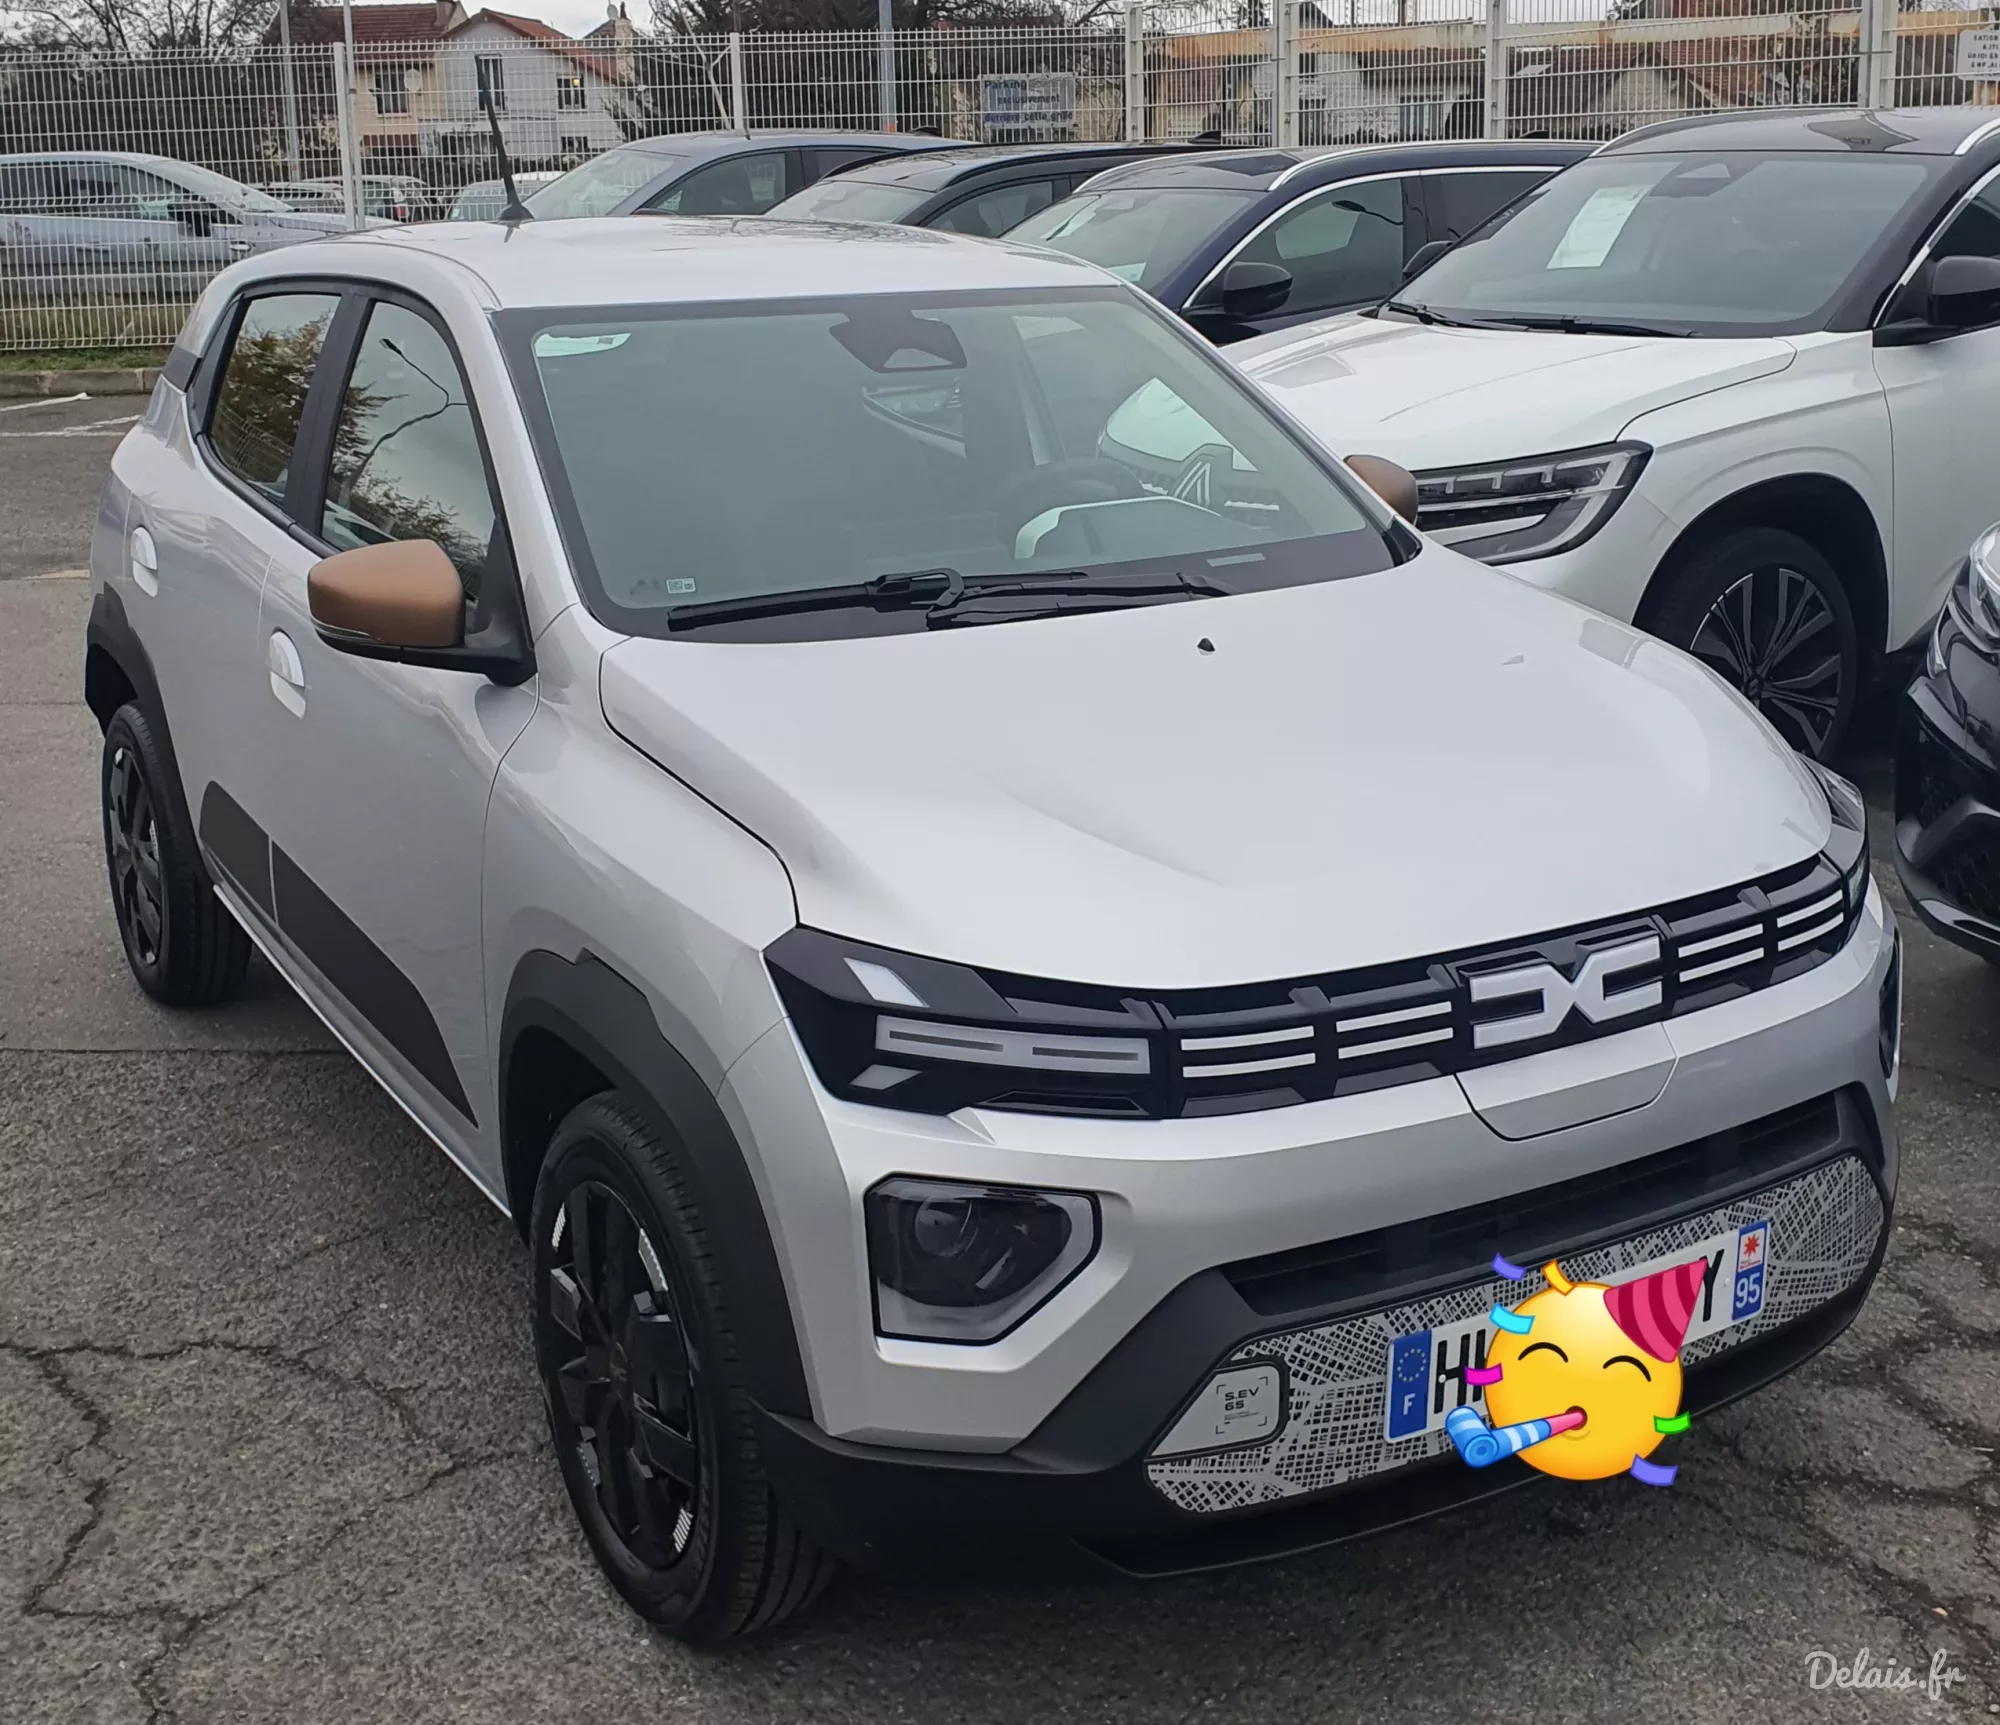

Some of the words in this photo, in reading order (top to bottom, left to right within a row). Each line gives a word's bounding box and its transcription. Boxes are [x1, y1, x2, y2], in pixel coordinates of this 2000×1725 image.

[984, 80, 1027, 91] Parking
[997, 94, 1060, 104] exclusivement
[1024, 112, 1047, 121] cette
[1051, 111, 1073, 122] grille
[1403, 1393, 1416, 1416] F
[1735, 1272, 1760, 1309] 95
[1224, 1400, 1245, 1411] 65
